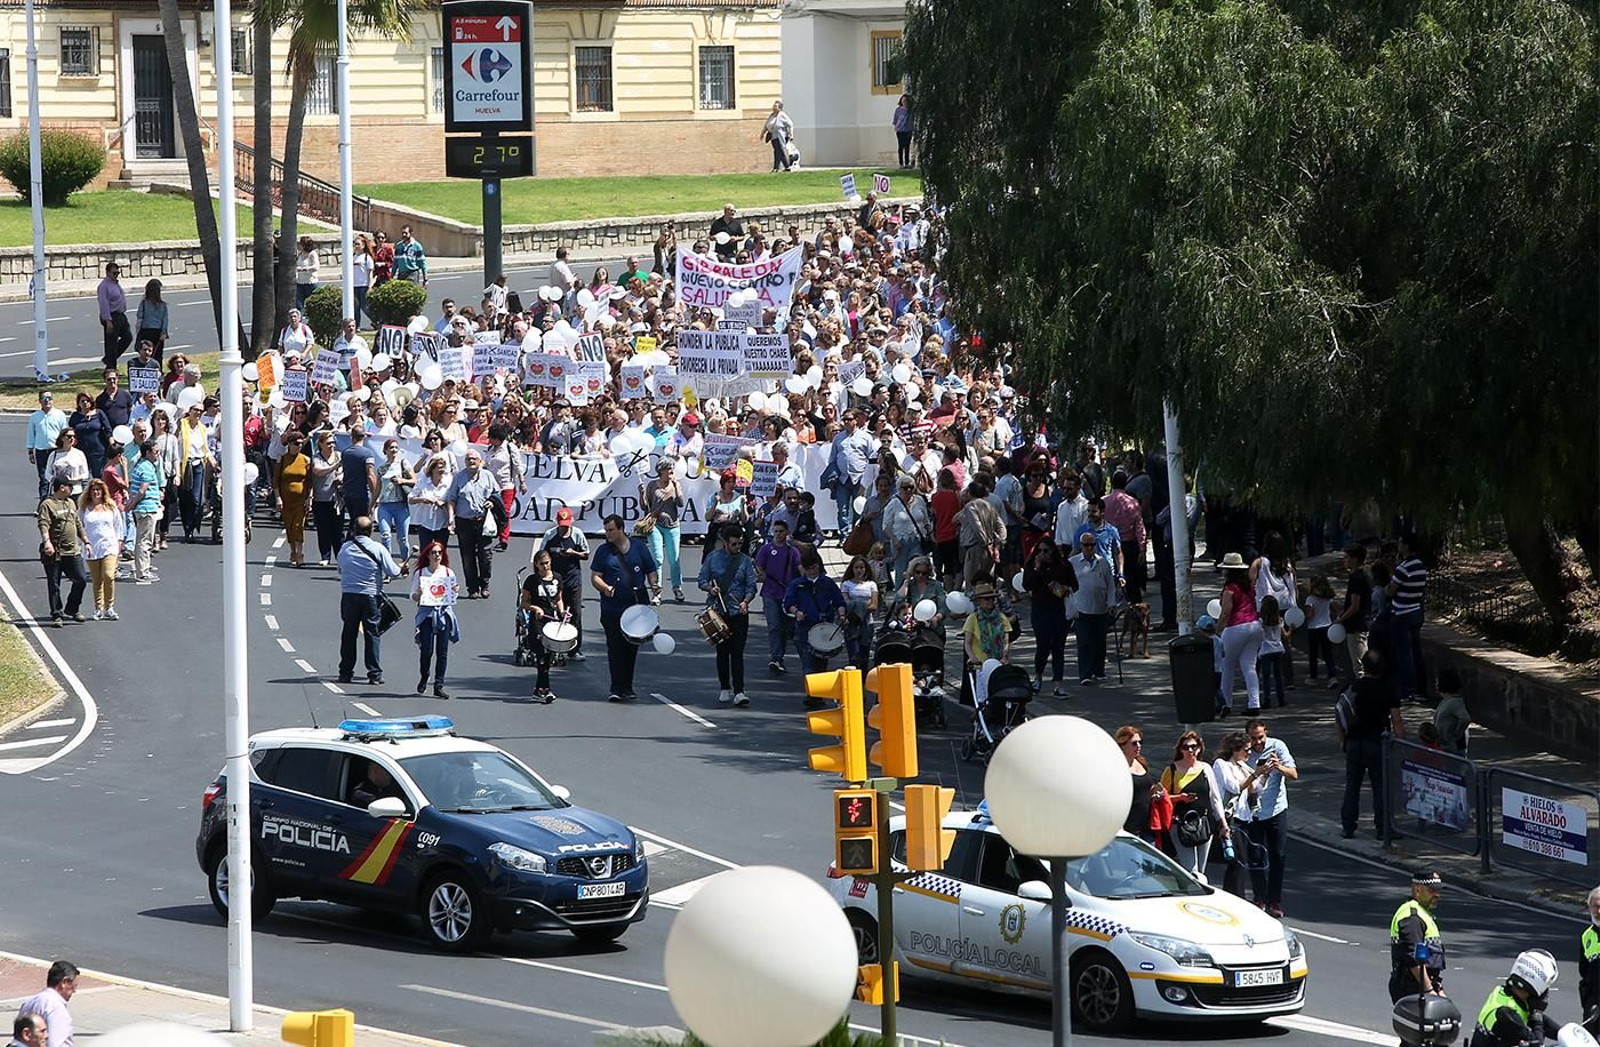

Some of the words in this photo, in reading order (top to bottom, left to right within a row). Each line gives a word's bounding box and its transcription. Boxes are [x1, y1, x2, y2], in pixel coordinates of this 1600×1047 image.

[455, 89, 520, 102] Carrefour
[874, 175, 889, 193] NO
[681, 272, 725, 289] NUEVO
[728, 274, 785, 290] CENTRO
[381, 328, 403, 356] NO
[579, 334, 603, 362] NO
[679, 333, 703, 349] HUNDEN
[705, 334, 713, 349] LA
[746, 336, 782, 347] QUEREMOS
[744, 348, 768, 359] NUESTRO
[769, 348, 788, 359] CHARE
[709, 357, 716, 374] LA
[139, 370, 159, 379] VENDE
[139, 379, 158, 390] SALUD
[283, 389, 304, 398] MATAN
[523, 453, 614, 484] UELVA,
[1529, 796, 1556, 813] HIELOS
[263, 815, 290, 825] CUERPO
[290, 819, 321, 831] NACIONAL
[322, 825, 334, 833] DE
[1520, 805, 1567, 829] ALVARADO
[261, 821, 350, 854] POLICÍA
[1524, 823, 1540, 833] VENTA
[1547, 829, 1563, 840] HIELO
[582, 883, 625, 898] CNP8014AR
[910, 931, 983, 964] POLICÍA
[983, 946, 1047, 978] LOCAL
[1242, 973, 1264, 985] 5845
